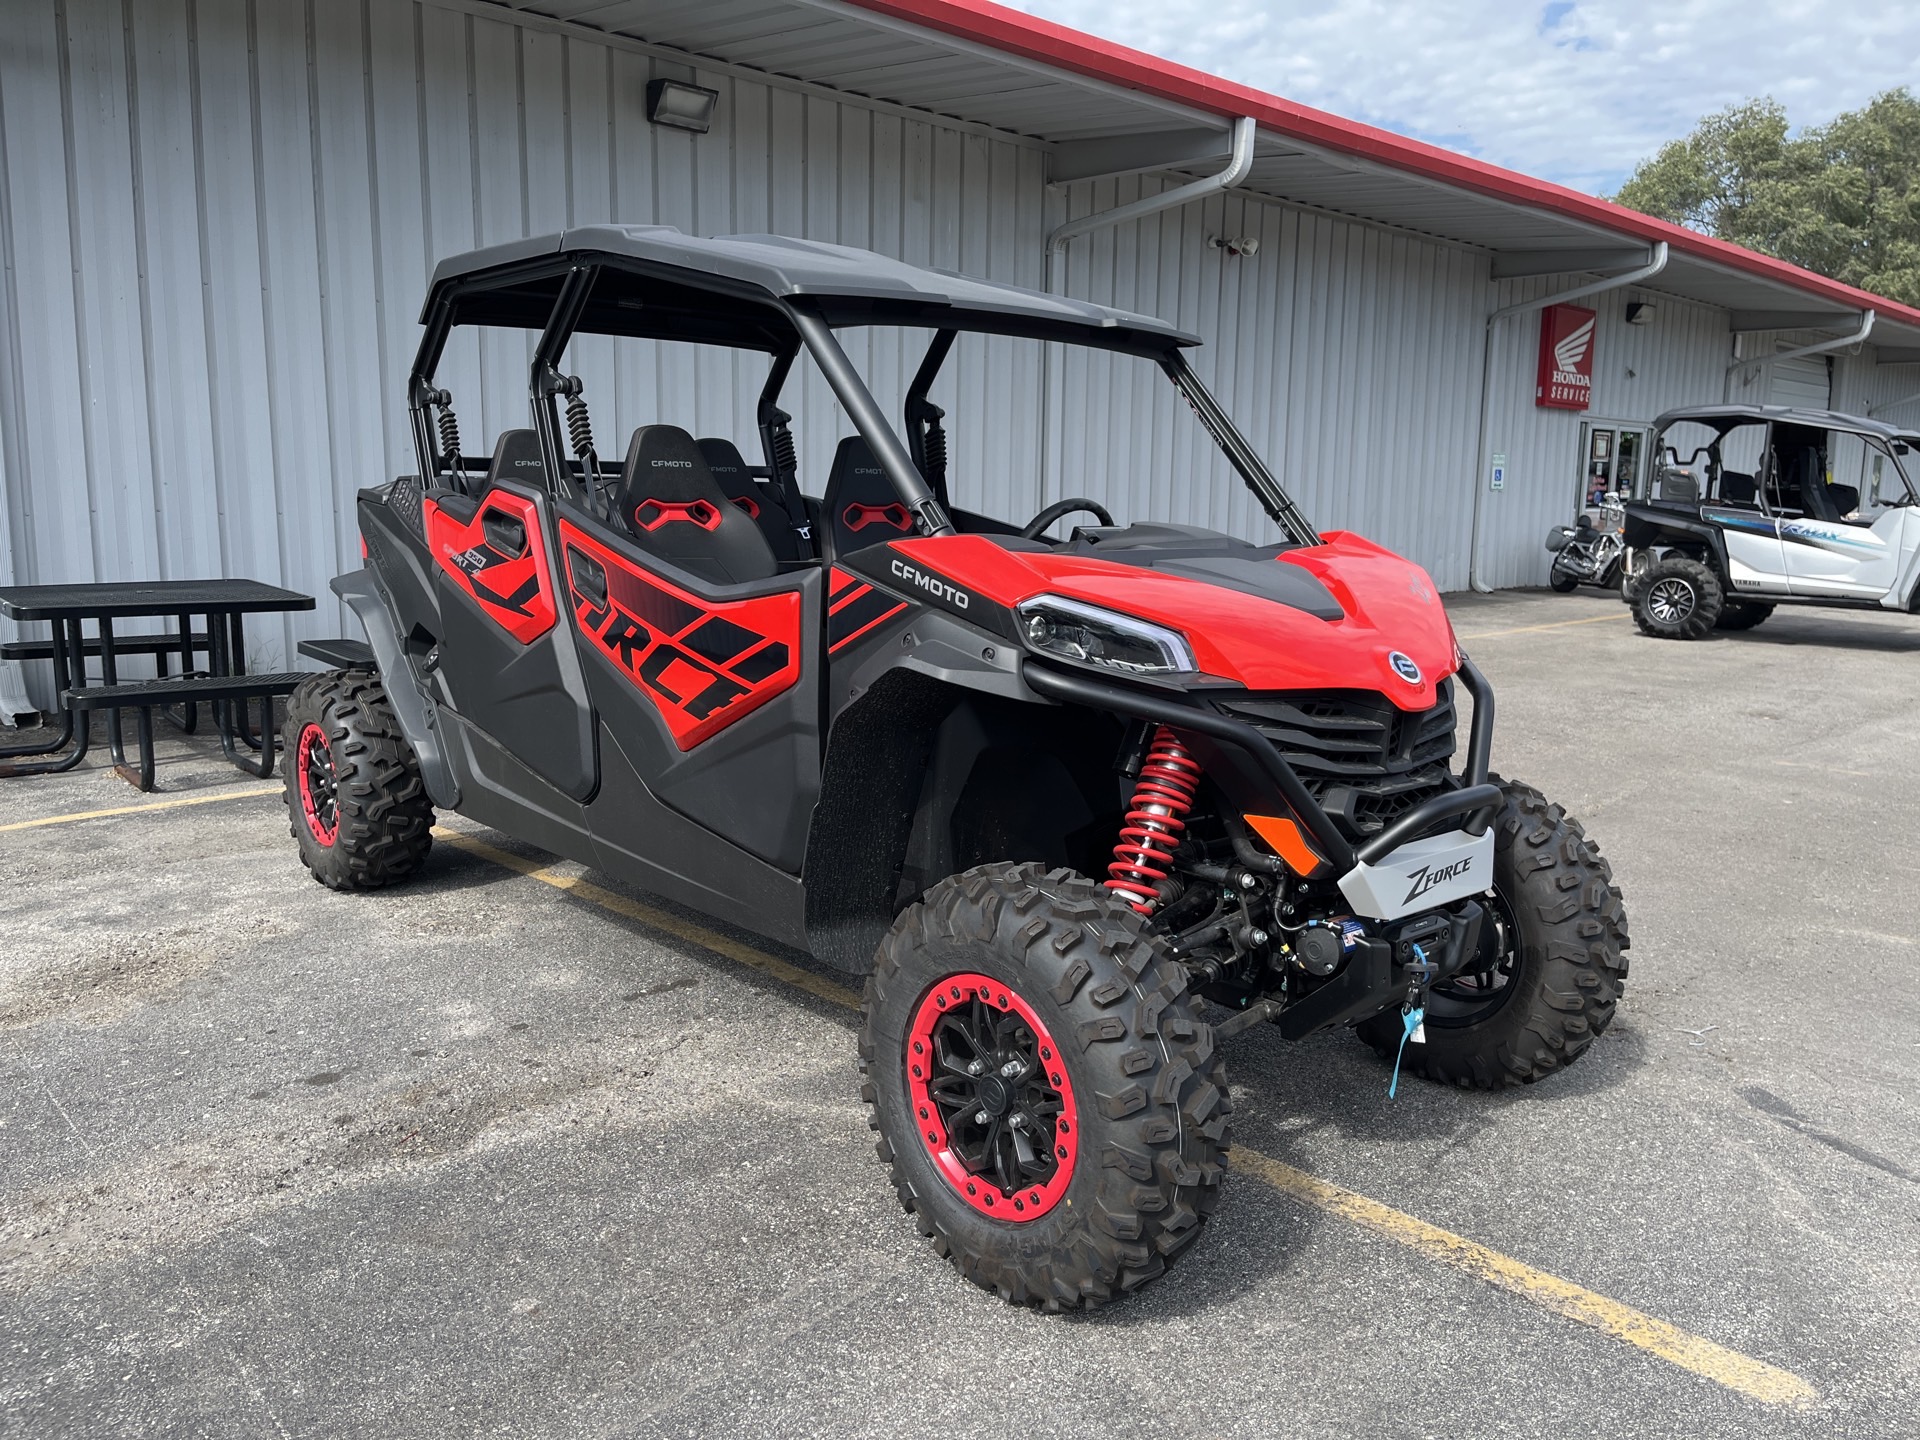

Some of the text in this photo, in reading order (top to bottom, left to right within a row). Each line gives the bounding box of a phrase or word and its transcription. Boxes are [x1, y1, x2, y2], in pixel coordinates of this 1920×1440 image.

[1552, 370, 1591, 387] HONDA
[1551, 385, 1591, 403] SERVICE
[514, 460, 542, 468] CFMO
[651, 460, 692, 468] CFMOTO
[854, 467, 885, 475] CFMOT
[467, 550, 484, 566] 950
[891, 559, 969, 609] CFMOTO
[1734, 579, 1761, 588] YAMAHA
[1401, 855, 1474, 907] ZFORCE
